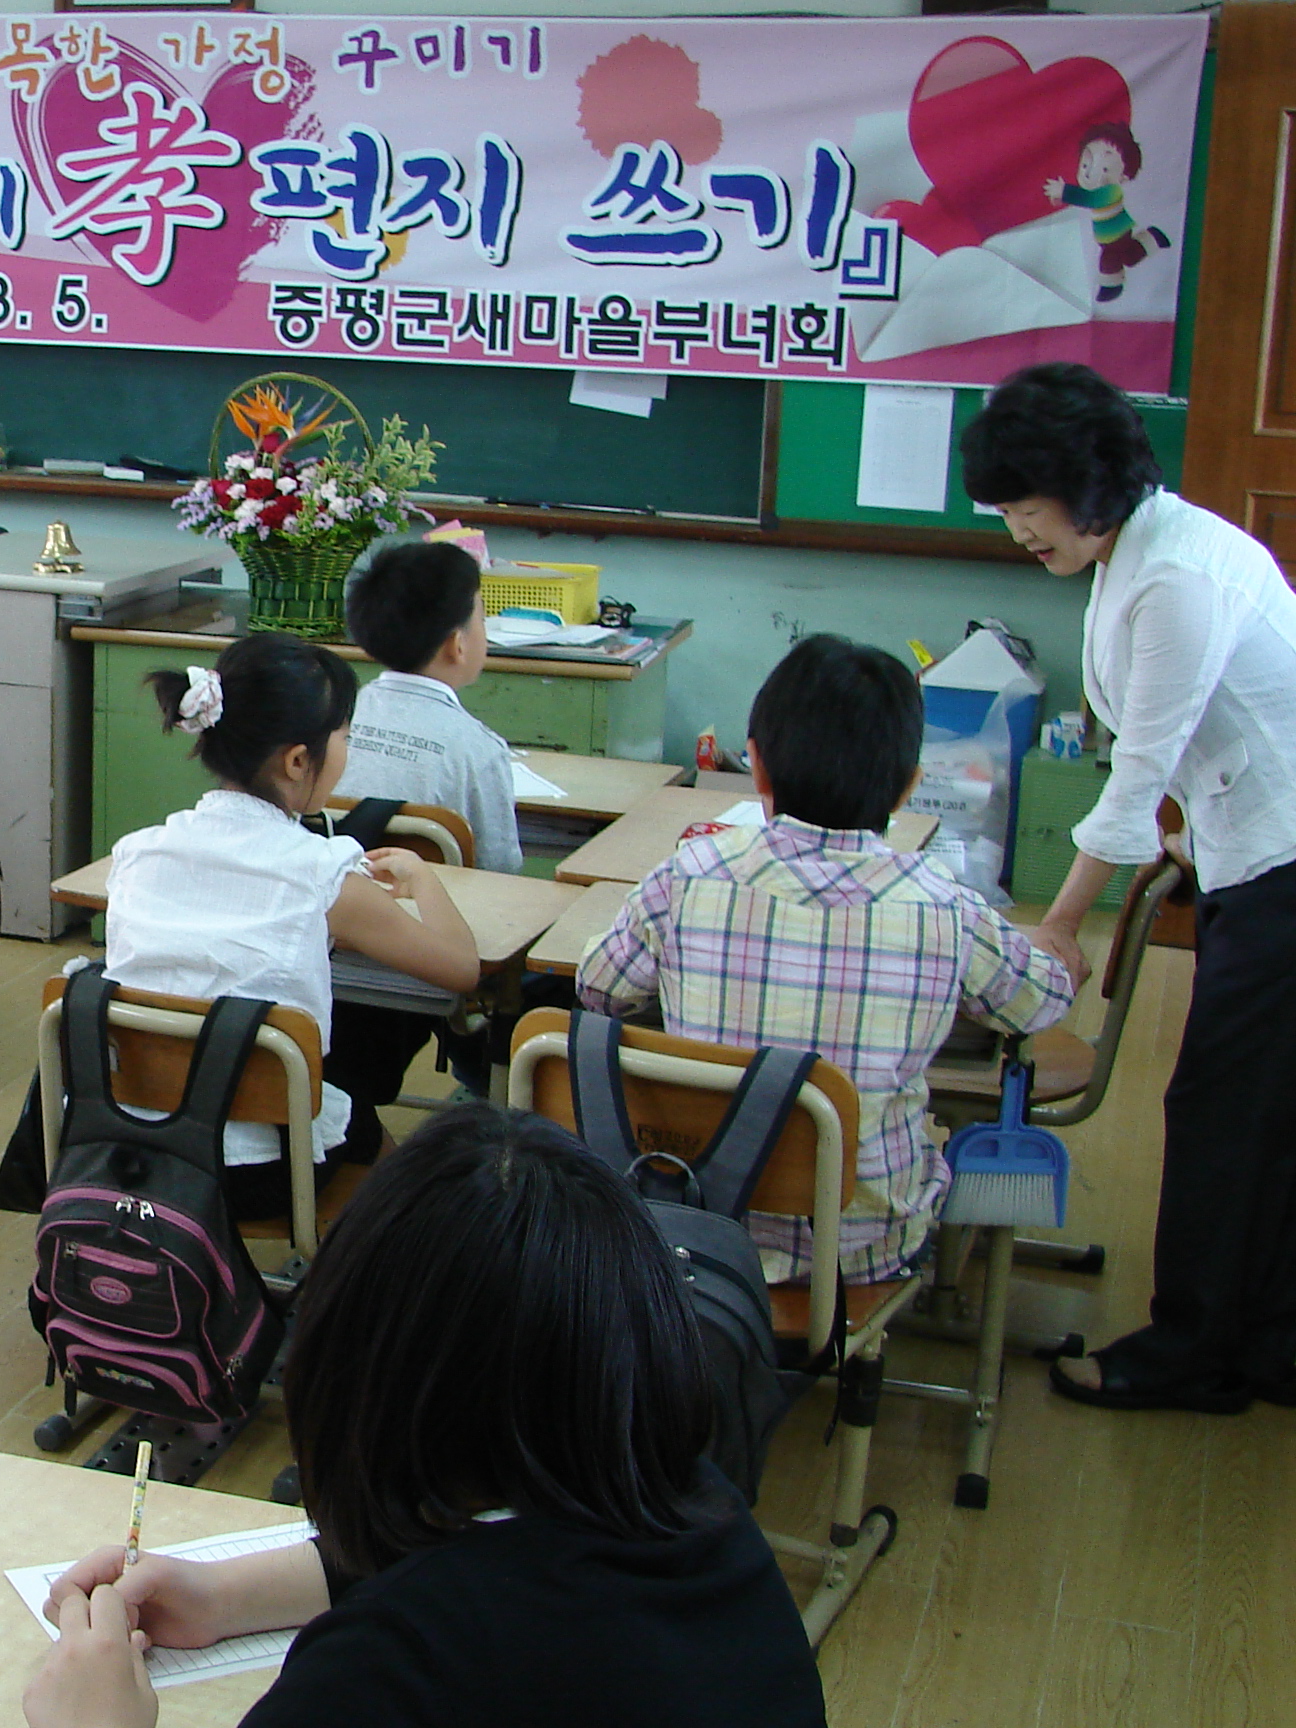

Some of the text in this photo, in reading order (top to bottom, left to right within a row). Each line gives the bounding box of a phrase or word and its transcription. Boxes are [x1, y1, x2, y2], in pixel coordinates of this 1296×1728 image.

[161, 24, 289, 98] 가정
[336, 23, 544, 91] 꾸미기
[50, 88, 238, 280] 孝
[254, 128, 518, 276] 편지
[53, 273, 109, 334] 5.
[271, 283, 847, 369] 증평군새마을부녀회
